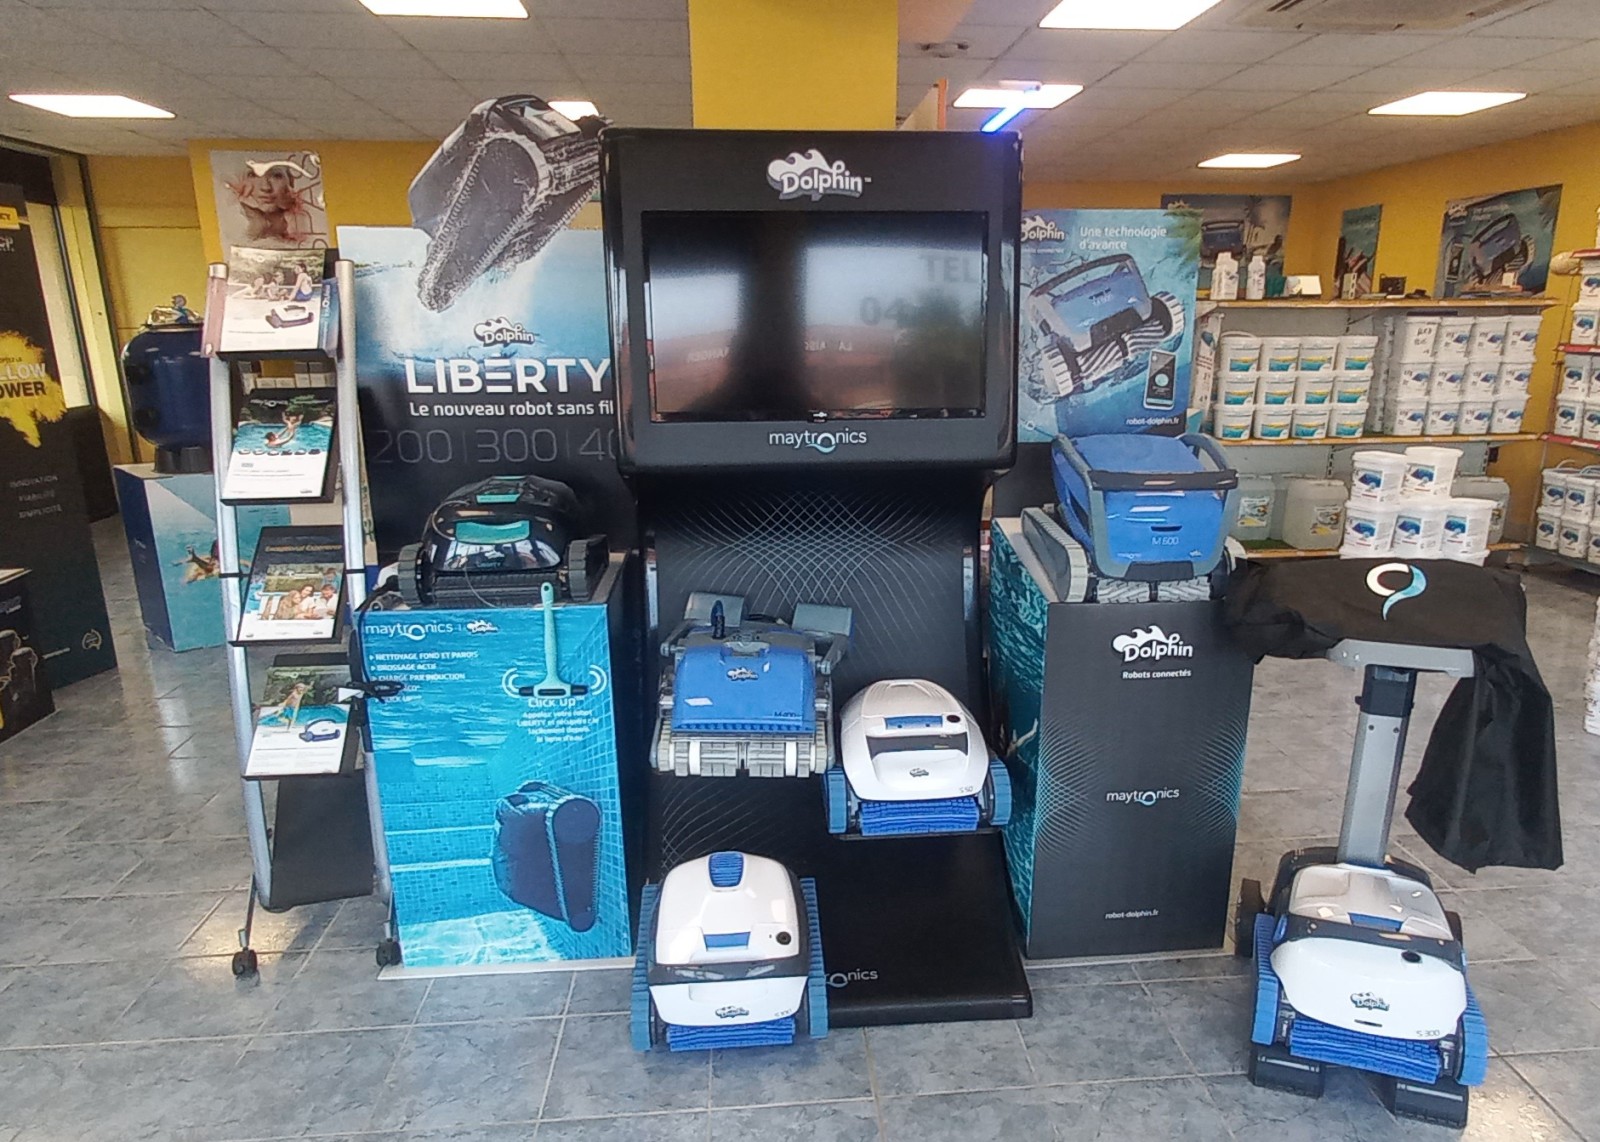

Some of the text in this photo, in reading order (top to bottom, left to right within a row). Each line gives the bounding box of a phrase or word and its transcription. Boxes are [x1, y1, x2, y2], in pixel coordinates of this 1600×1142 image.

[776, 159, 863, 198] Dolphin
[1080, 226, 1167, 240] Une technologie
[1079, 240, 1128, 251] d'avance
[479, 321, 535, 345] Dolphin
[404, 357, 612, 394] LIBERTY
[410, 401, 614, 417] Le nouveau robot sans fil
[370, 429, 451, 463] 200
[474, 428, 557, 463] 300
[768, 428, 868, 454] maytronics
[364, 620, 454, 640] maytronics
[1119, 631, 1194, 662] Dolphin
[1122, 668, 1192, 679] Robots connectés
[1105, 787, 1181, 806] maytronics
[1104, 909, 1160, 919] robot-dolphin.fr
